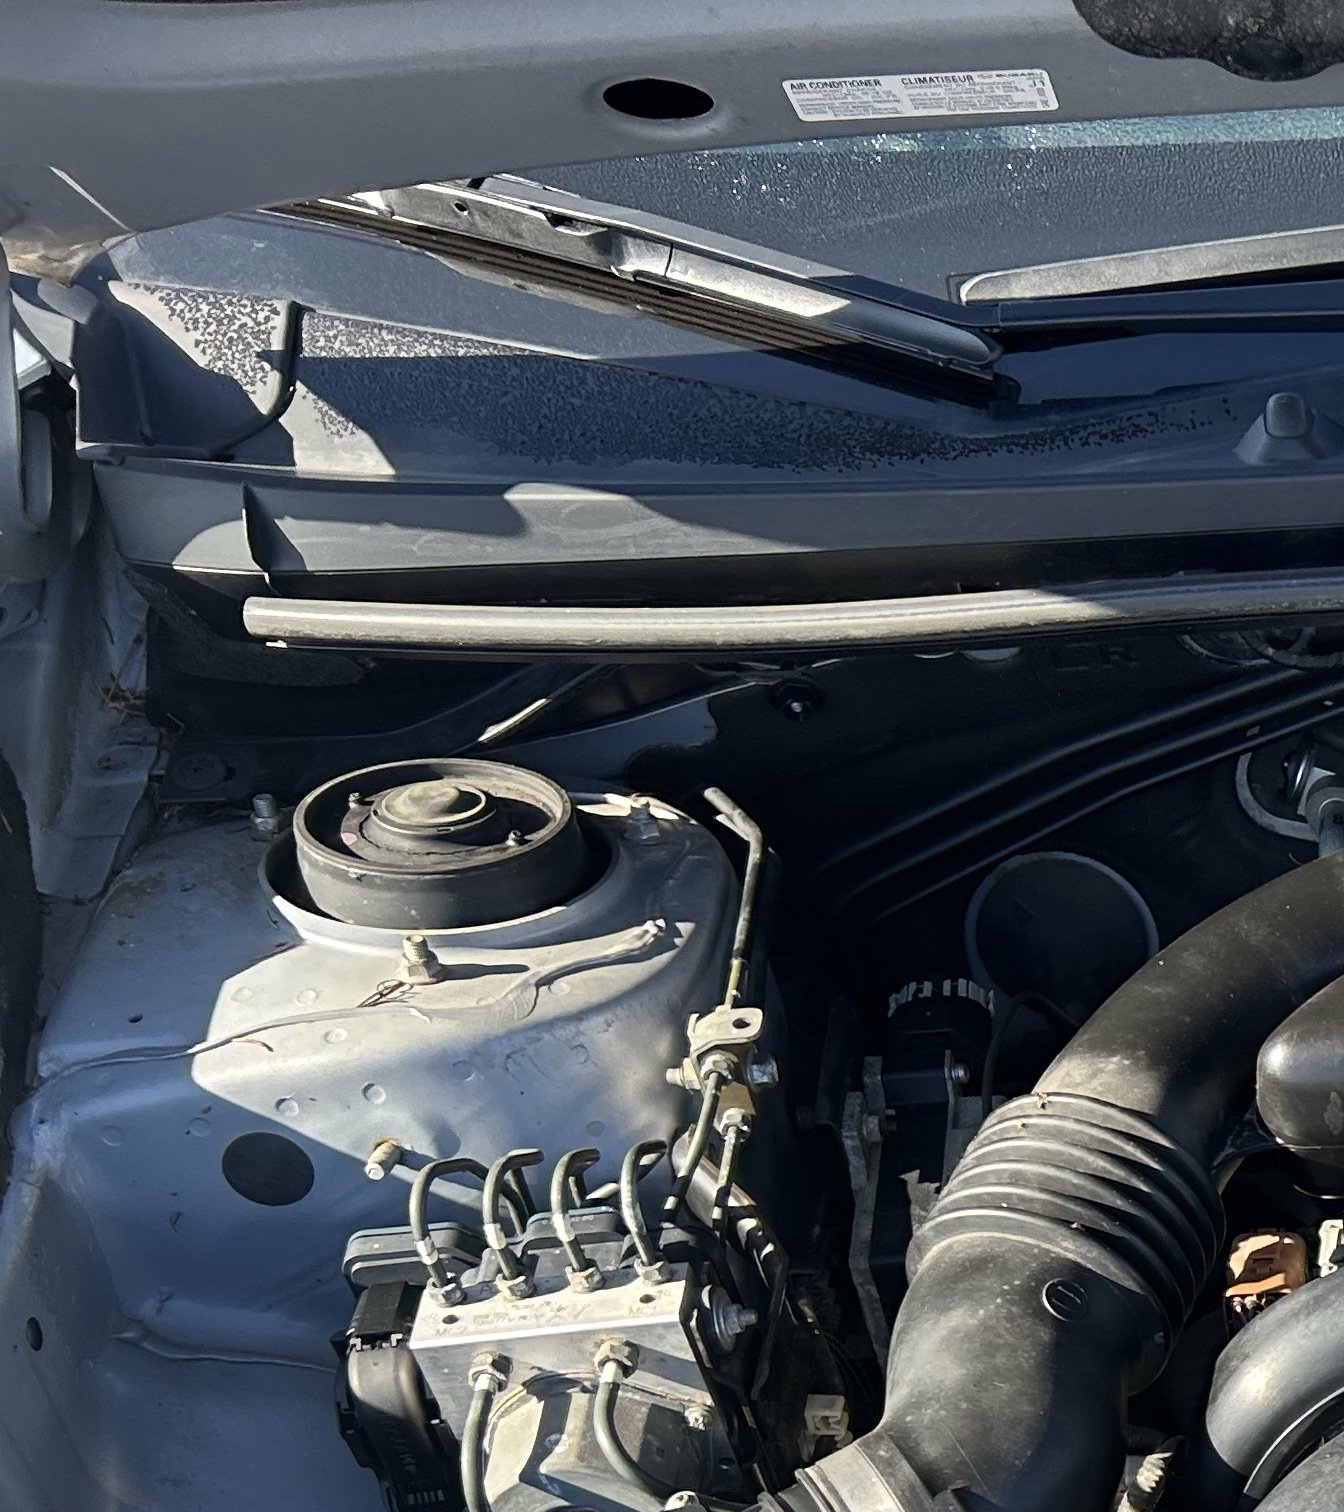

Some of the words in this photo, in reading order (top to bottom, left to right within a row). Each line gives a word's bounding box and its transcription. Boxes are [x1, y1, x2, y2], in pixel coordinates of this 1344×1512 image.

[790, 82, 808, 91] AIR
[809, 79, 882, 90] CONDITIONER
[901, 74, 974, 85] CLIMATISEUR
